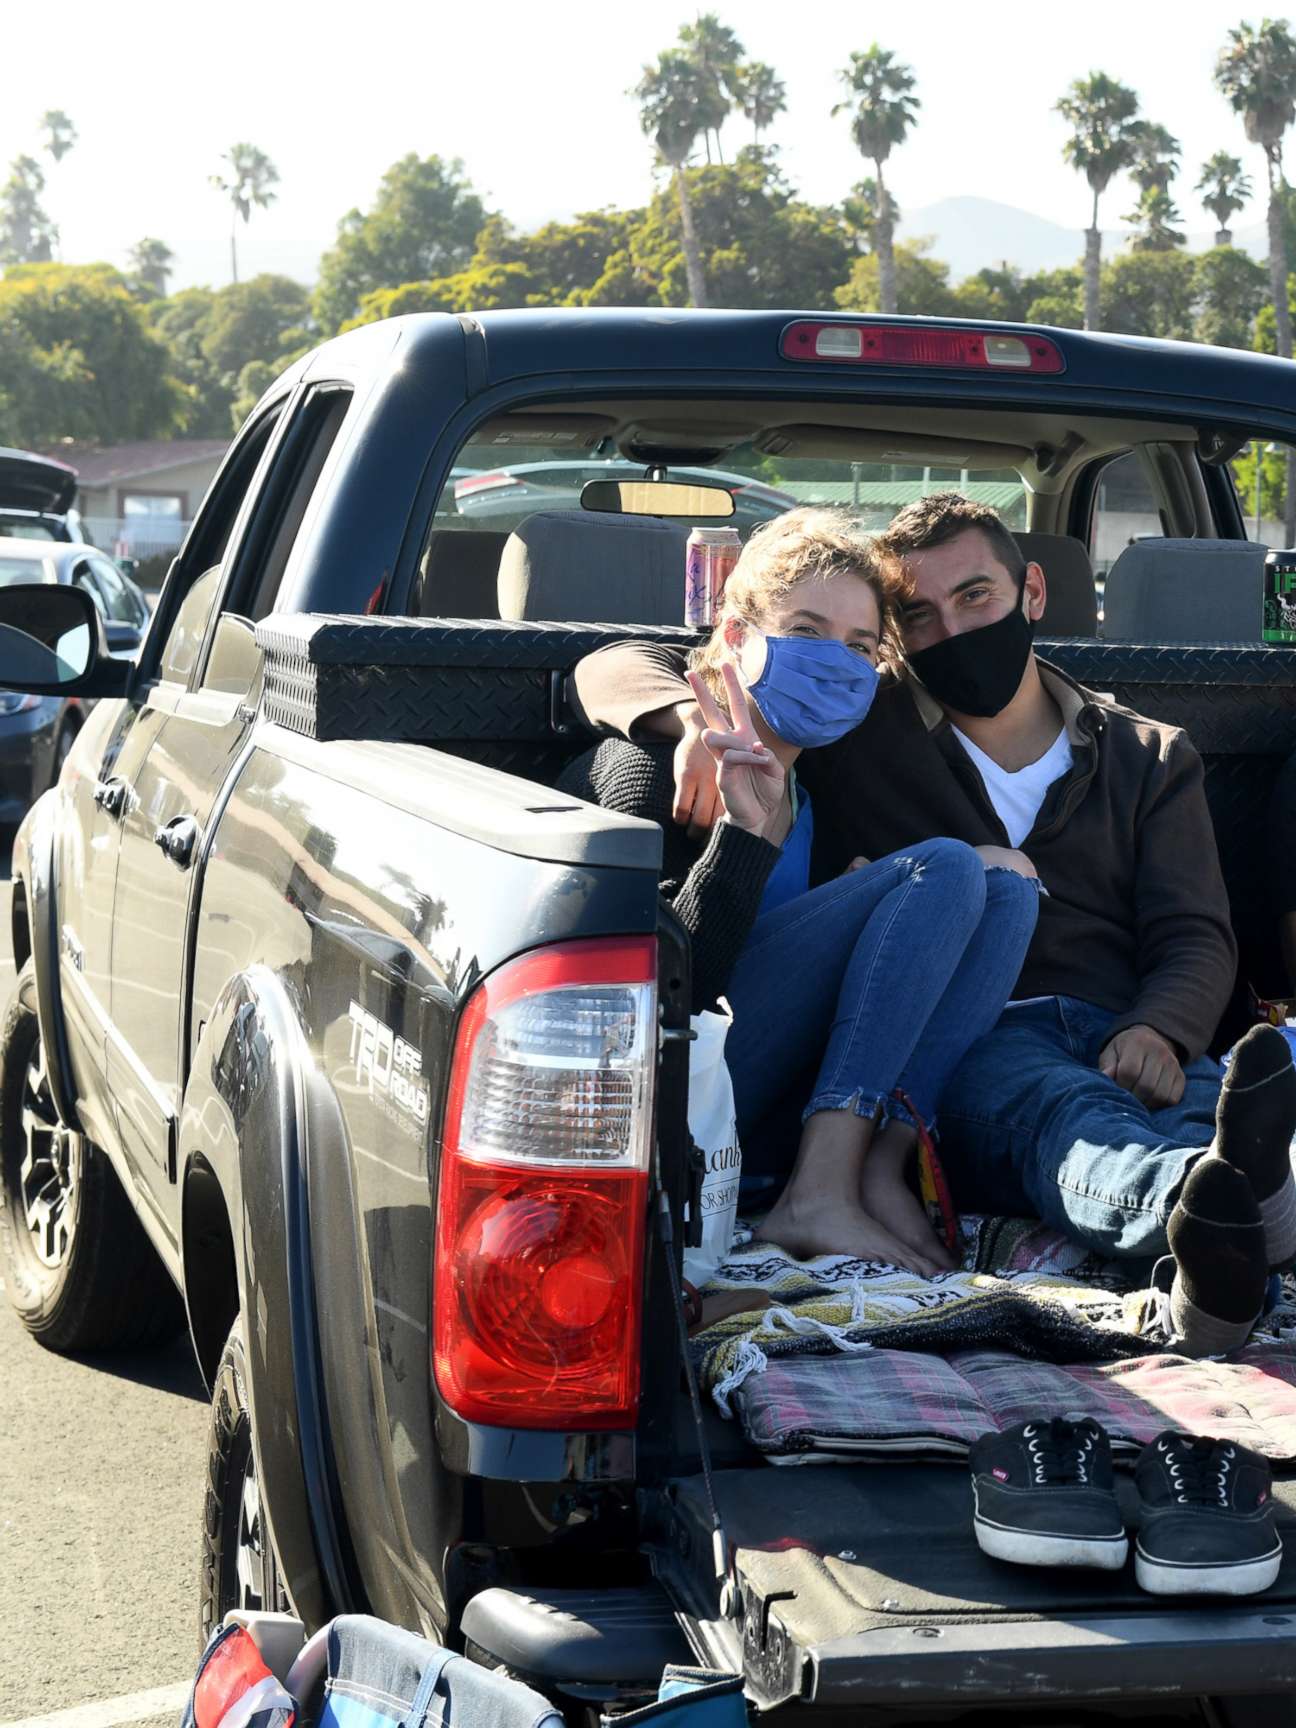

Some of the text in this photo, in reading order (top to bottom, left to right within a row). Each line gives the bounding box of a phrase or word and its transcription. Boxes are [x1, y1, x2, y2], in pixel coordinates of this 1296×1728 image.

[348, 999, 394, 1102] TRD
[393, 1036, 423, 1077] OFF
[390, 1069, 428, 1126] ROAD
